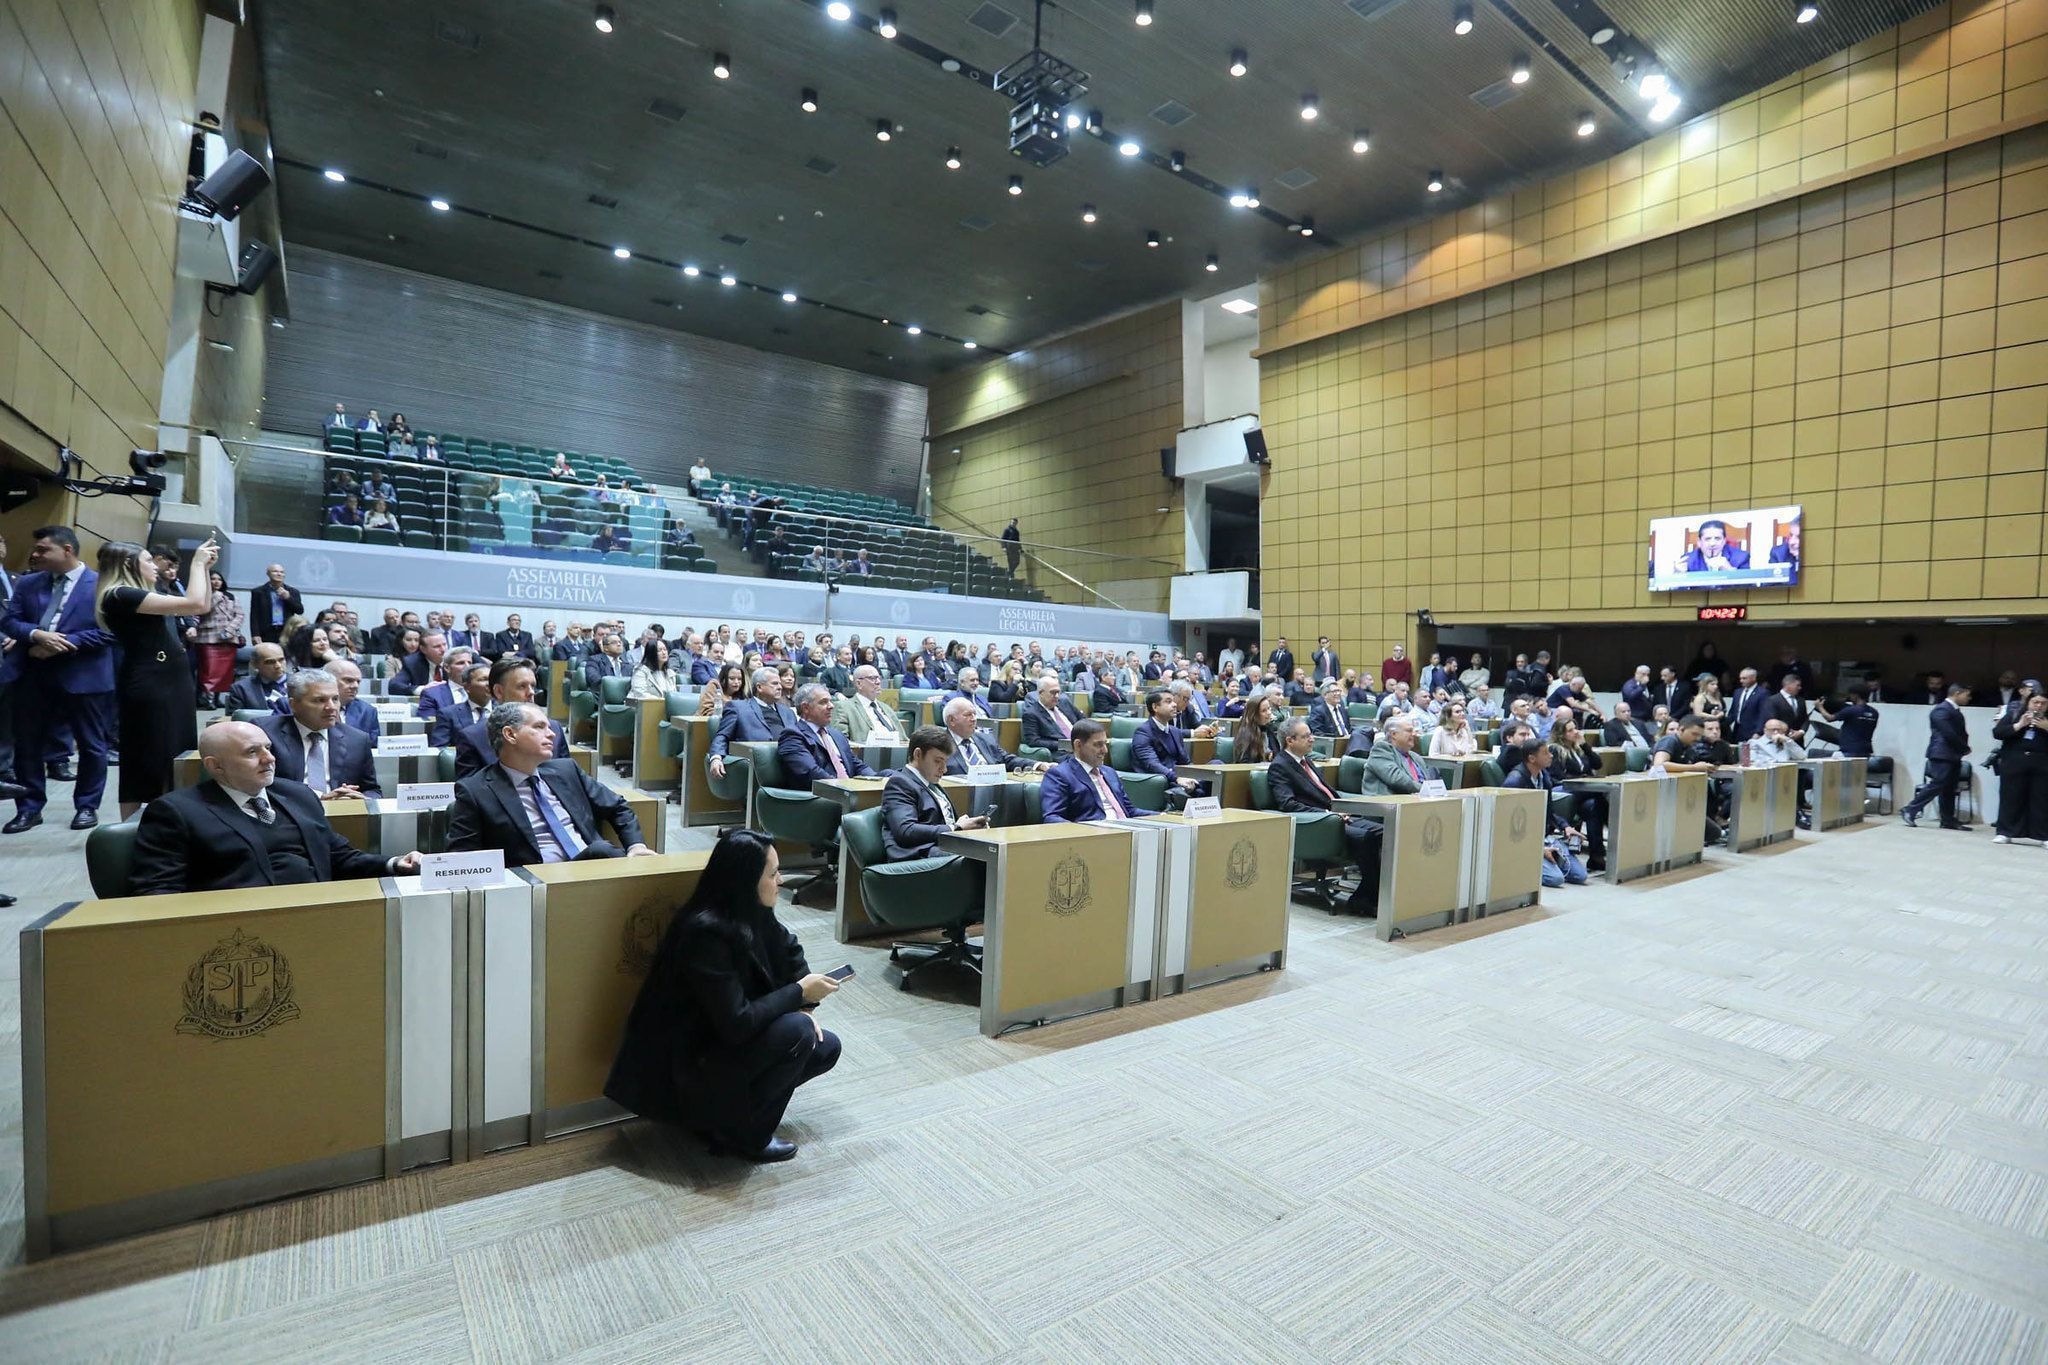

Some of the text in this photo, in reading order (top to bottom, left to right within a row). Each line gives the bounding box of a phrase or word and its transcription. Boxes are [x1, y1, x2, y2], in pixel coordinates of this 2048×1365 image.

[506, 567, 607, 589] ASSEMBLEIA
[506, 583, 606, 604] LEGISLATIVA
[1000, 607, 1056, 622] ASSEMBLEIA
[999, 619, 1056, 633] LEGISLATIVA
[435, 866, 492, 877] RESERVADO
